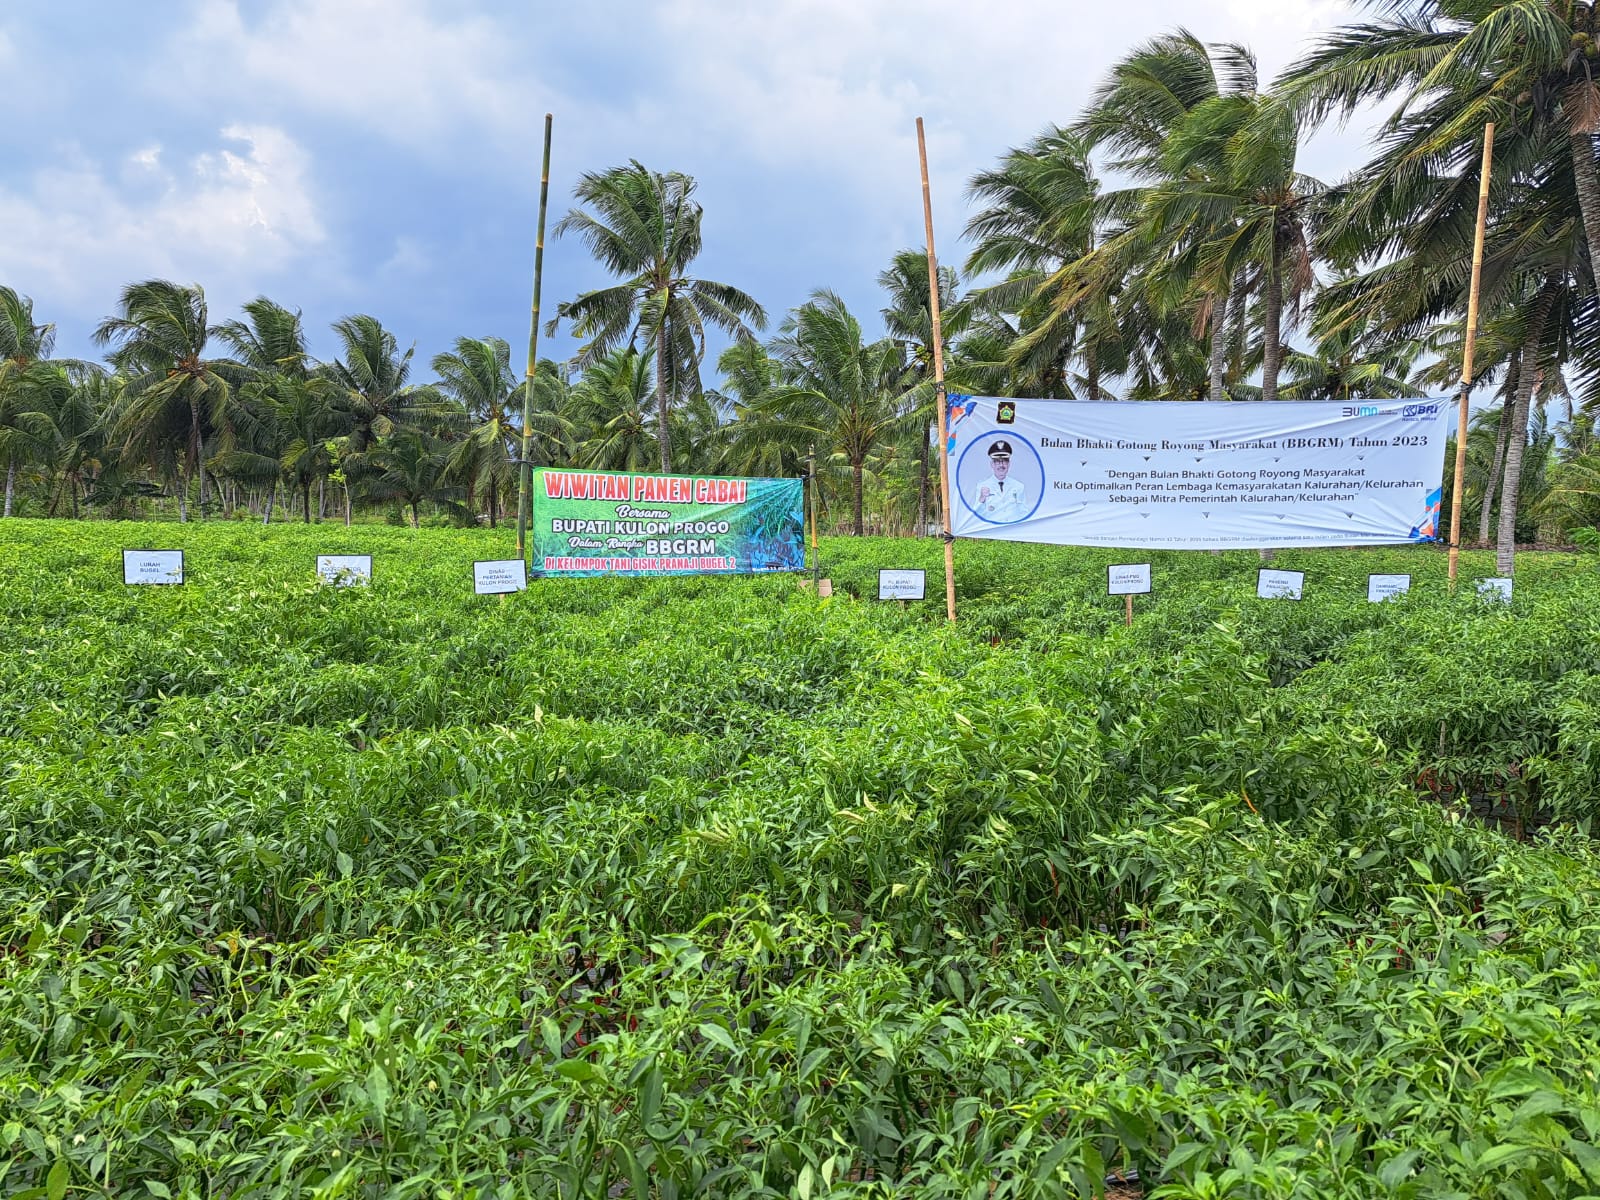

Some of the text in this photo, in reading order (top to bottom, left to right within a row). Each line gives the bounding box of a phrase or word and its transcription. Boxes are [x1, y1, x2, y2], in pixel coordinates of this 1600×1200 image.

[1418, 404, 1438, 415] BRI
[1041, 436, 1428, 453] Bulan Bhakti Gotong Royong Masyarakat (BBGRM) Tahun 2023
[1150, 470, 1179, 479] Bulan
[1182, 470, 1214, 479] Bhakti
[1217, 470, 1257, 480] Gotong
[1260, 469, 1300, 480] Royong
[1303, 468, 1366, 479] Masyarakat
[544, 471, 747, 503] WIWITAN PANEN CABAI
[1053, 480, 1424, 493] Kita Optimalkan Peran Lembaga Kemasyarakatan Kalurahan/Kelurahan
[1109, 494, 1148, 504] Sebagai
[1150, 494, 1177, 503] Mitra
[1179, 494, 1237, 503] Pemerintah
[615, 504, 671, 519] Bersama
[552, 519, 729, 534] BUPATI KULON PROGO
[568, 536, 715, 555] Dalam Rangka BBGRM
[545, 557, 736, 571] DI KELOMPOK TANI GISIK PRANAJI BUGEL 2
